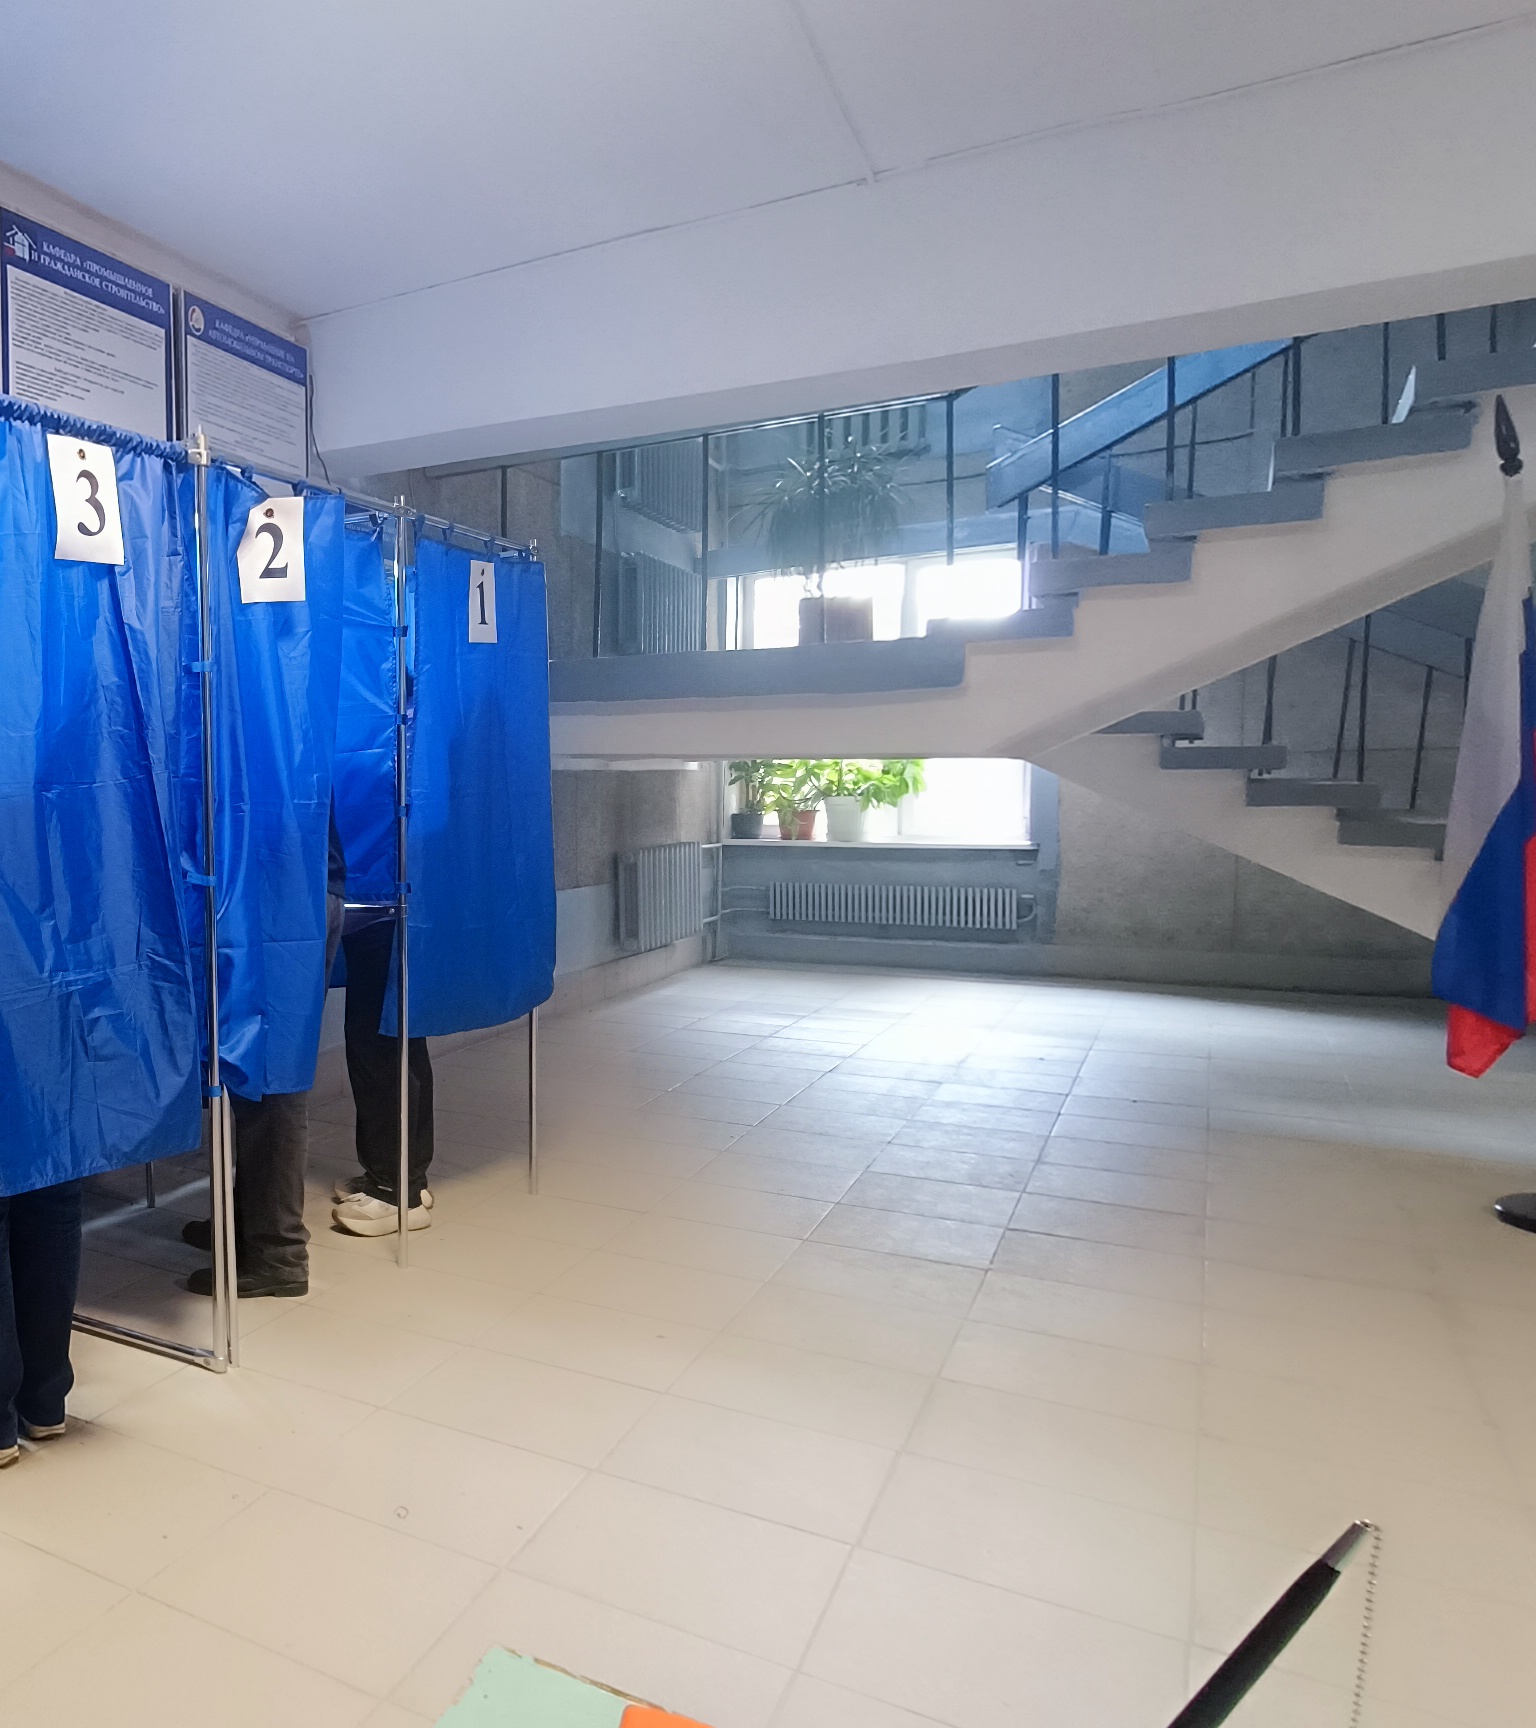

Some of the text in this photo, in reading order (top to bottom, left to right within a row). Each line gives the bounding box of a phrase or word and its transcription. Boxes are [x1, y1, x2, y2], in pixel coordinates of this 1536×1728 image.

[40, 254, 101, 288] ГРАЖДАНСКОЕ
[42, 241, 82, 267] КАФЕДРА
[75, 469, 106, 537] 3
[255, 522, 289, 579] 2
[476, 580, 489, 626] 1
